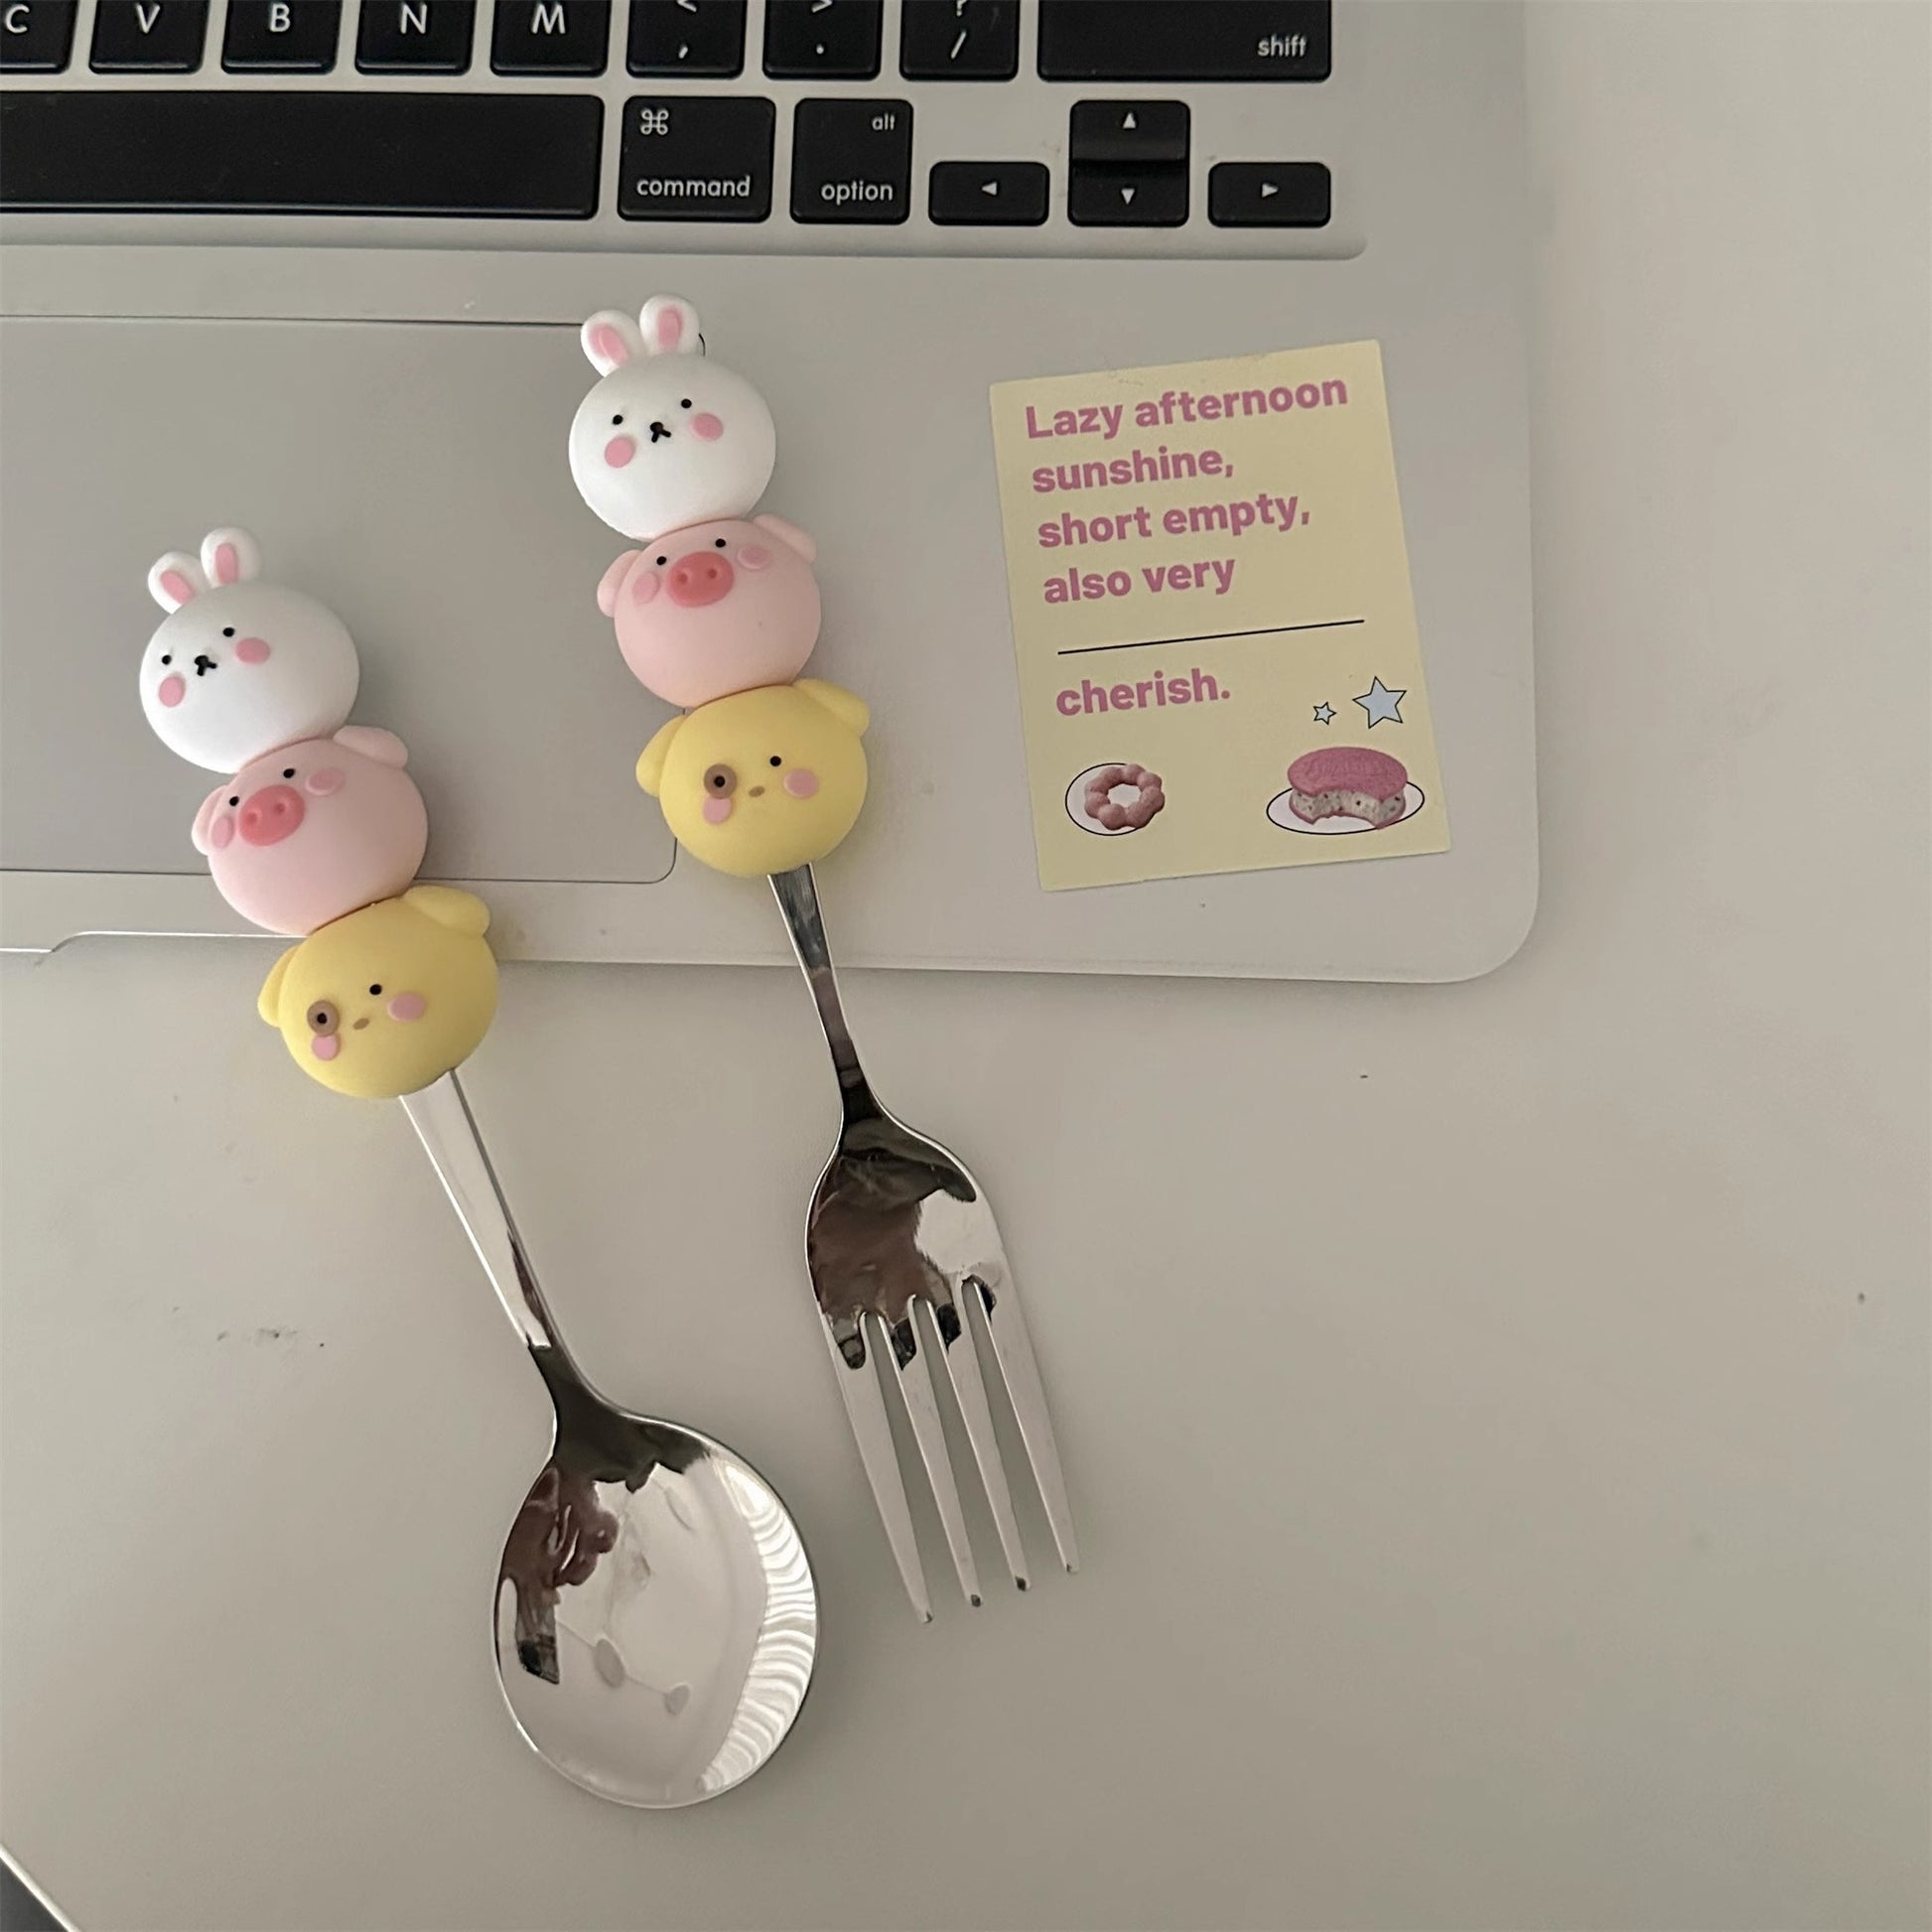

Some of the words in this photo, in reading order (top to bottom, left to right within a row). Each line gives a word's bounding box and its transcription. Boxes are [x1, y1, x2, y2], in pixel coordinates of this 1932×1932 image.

[4, 3, 31, 35] C
[135, 3, 162, 35] V
[268, 2, 292, 34] B
[399, 3, 429, 35] N
[530, 3, 567, 35] M
[950, 30, 968, 60] /
[1257, 35, 1307, 58] shift
[871, 113, 896, 131] alt
[636, 174, 752, 198] command
[820, 179, 894, 207] option
[1026, 404, 1124, 440] Lazy
[1135, 379, 1348, 428] afternoon
[1033, 446, 1234, 493] sunshine,
[1037, 506, 1152, 548] short
[1163, 493, 1311, 536] empty,
[1043, 567, 1133, 604] also
[1142, 559, 1235, 595] very
[1055, 667, 1231, 717] cherish.
